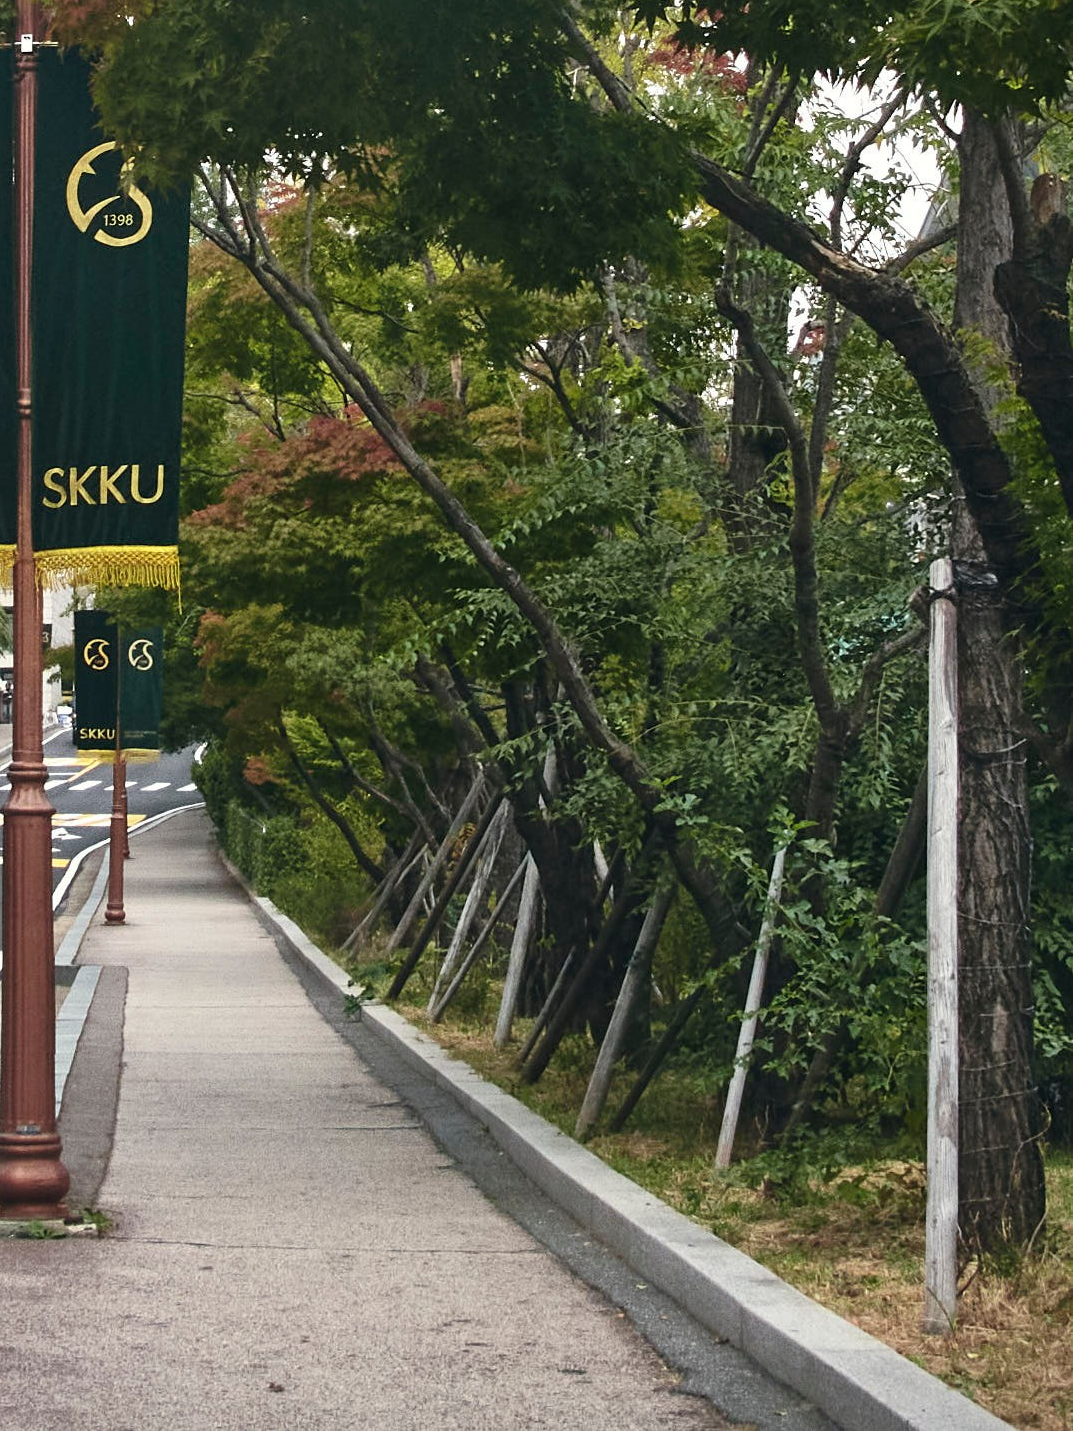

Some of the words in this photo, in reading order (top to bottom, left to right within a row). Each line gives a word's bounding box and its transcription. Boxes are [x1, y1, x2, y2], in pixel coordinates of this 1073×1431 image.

[103, 213, 134, 227] 1398
[42, 464, 165, 509] SKKU
[79, 727, 116, 740] SKKU
